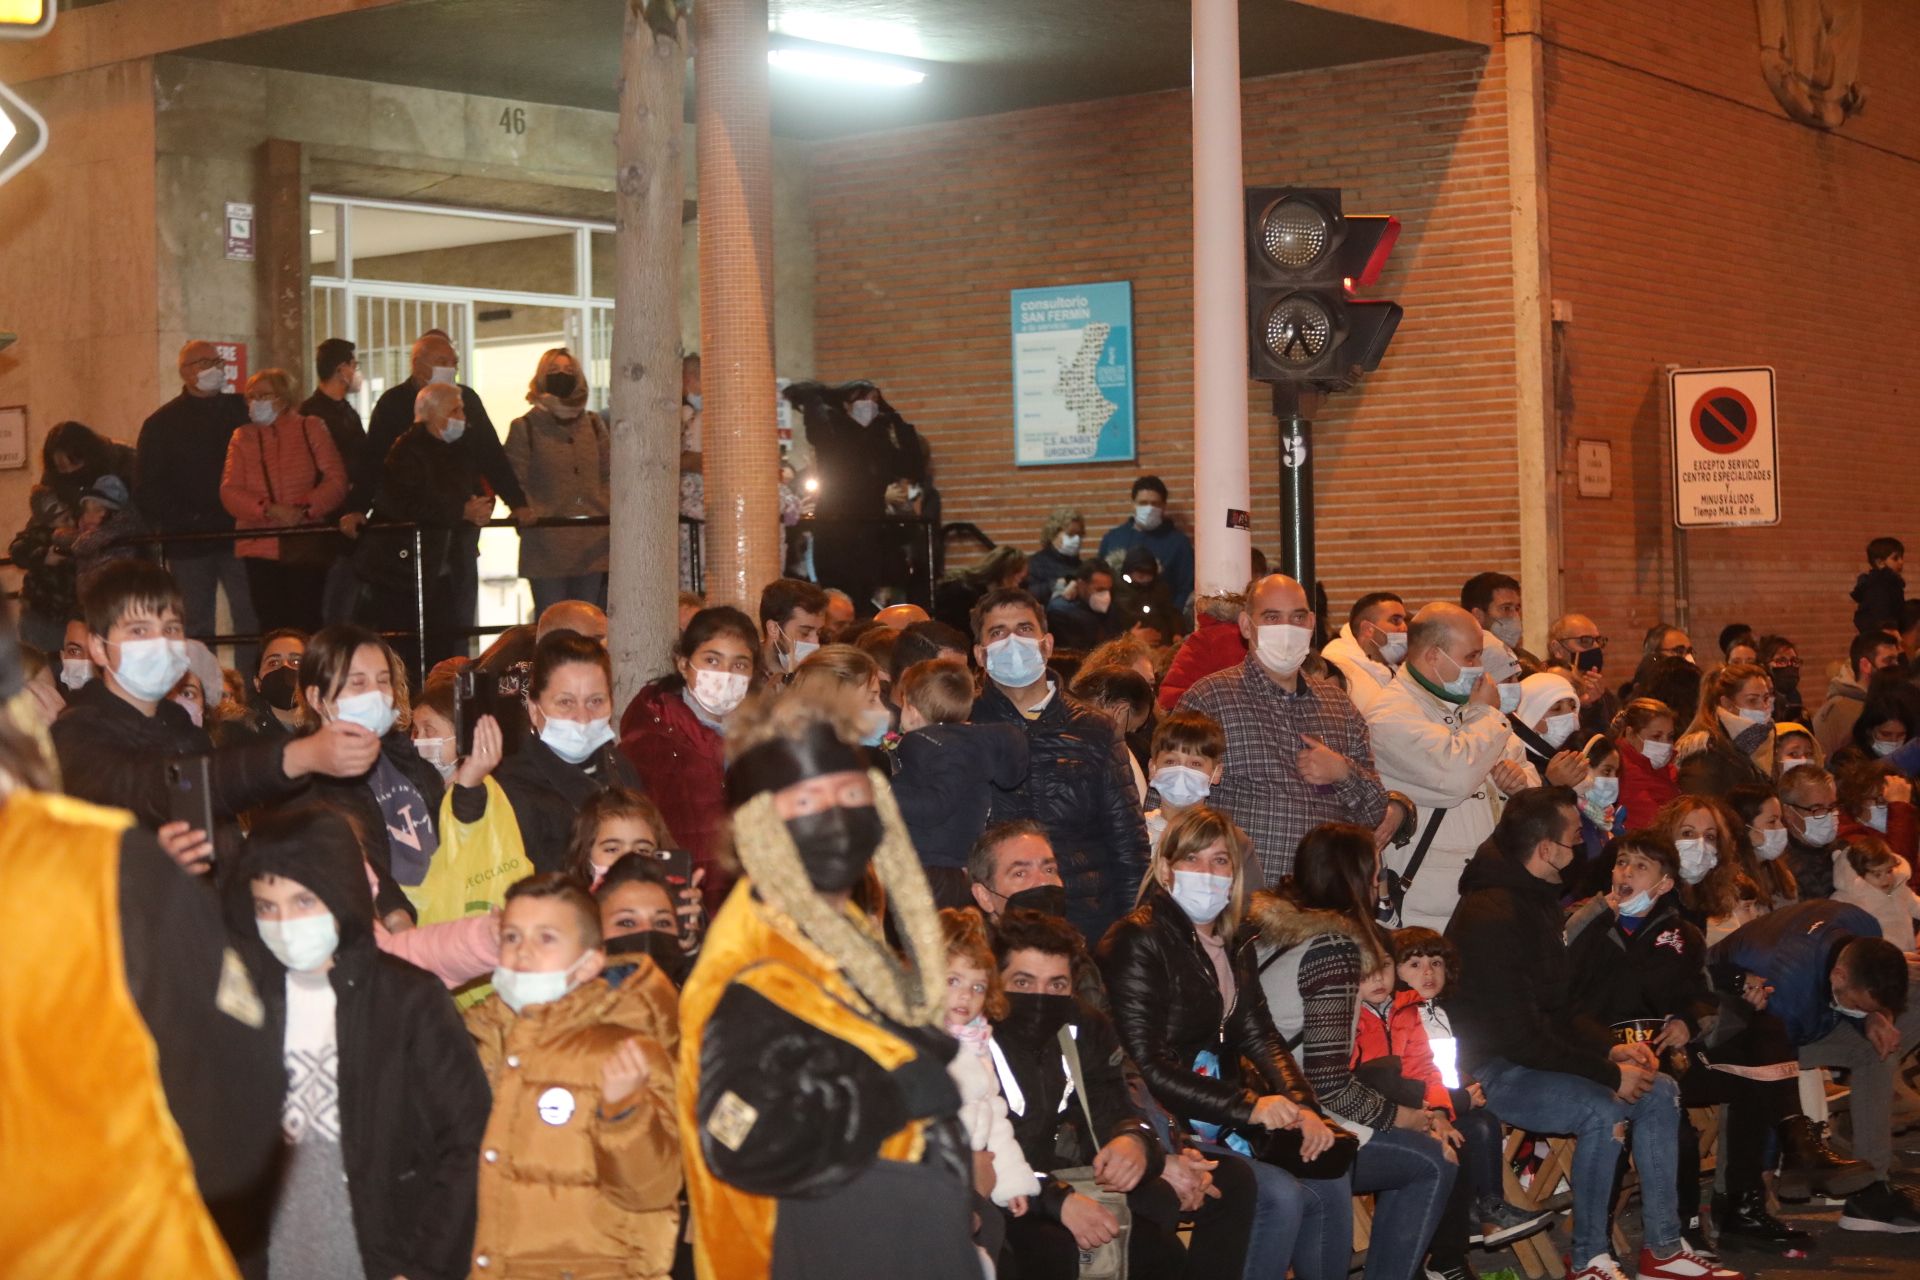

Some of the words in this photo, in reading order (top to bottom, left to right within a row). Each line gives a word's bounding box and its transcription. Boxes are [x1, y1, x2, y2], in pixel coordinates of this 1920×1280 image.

[499, 107, 526, 135] 46
[1021, 297, 1088, 311] consultorio
[1021, 310, 1045, 323] SAN
[1044, 446, 1091, 457] URGENCIAS
[1693, 460, 1725, 471] EXCEPTO
[1728, 459, 1760, 470] SERVICIO
[1682, 471, 1711, 482] CENTRO
[1713, 469, 1772, 481] ESPECIALIDADES
[1725, 483, 1730, 493] Y
[1693, 506, 1717, 519] Tiempo
[1738, 505, 1747, 515] 45
[465, 858, 520, 889] ECICLADO
